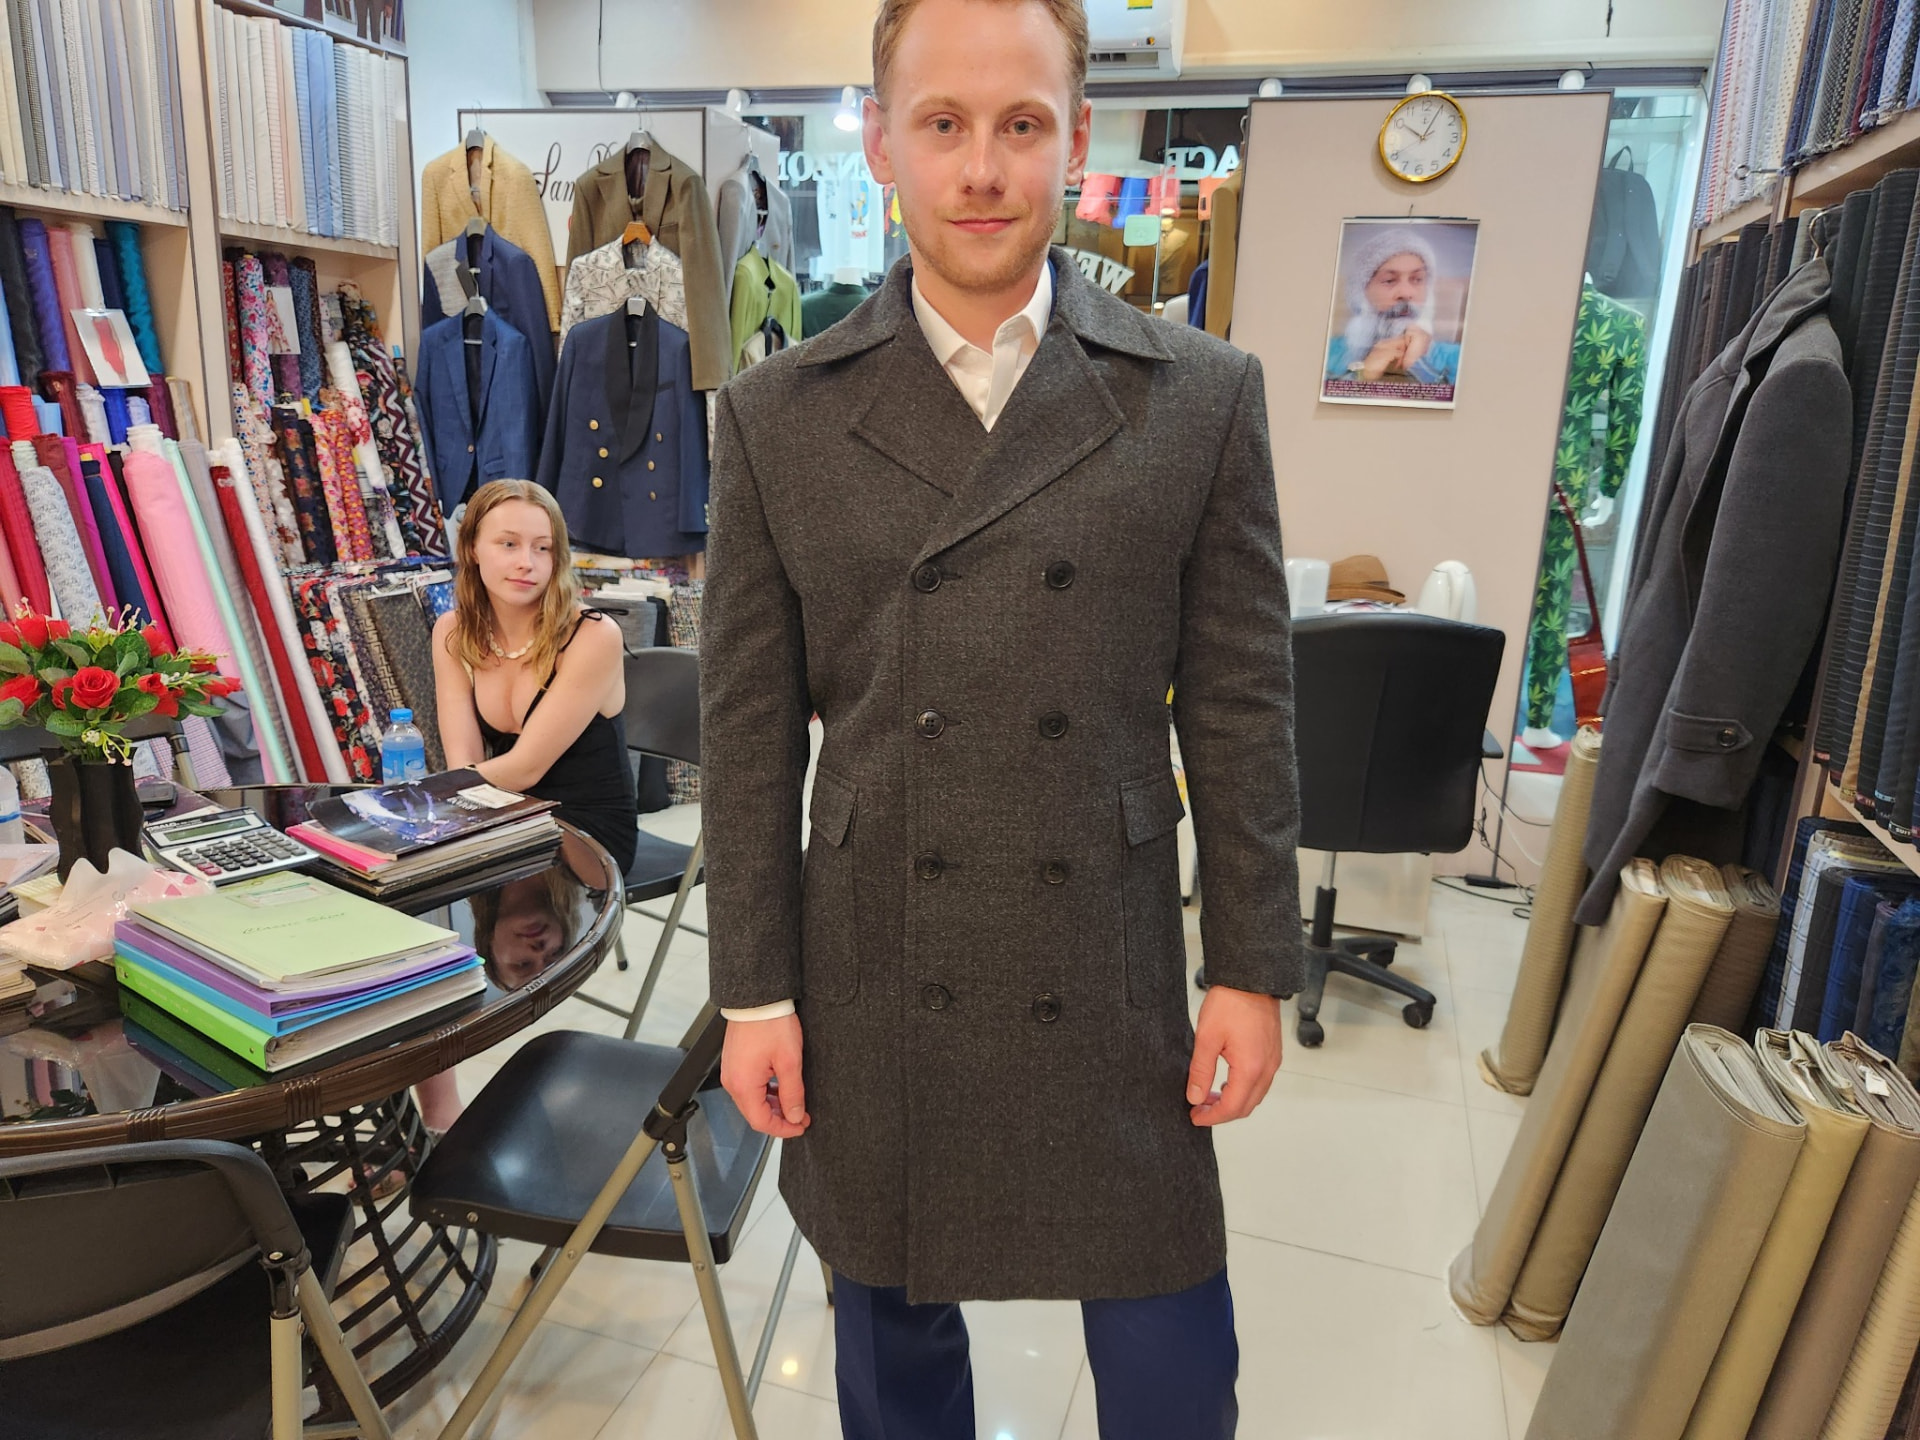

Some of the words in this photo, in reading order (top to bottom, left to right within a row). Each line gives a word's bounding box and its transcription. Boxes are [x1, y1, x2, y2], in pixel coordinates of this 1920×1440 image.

[1421, 100, 1432, 112] 12
[1406, 106, 1415, 117] 11
[1448, 115, 1456, 126] 2
[1450, 132, 1459, 143] 3
[1442, 147, 1451, 157] 4
[1402, 161, 1409, 171] 7
[1414, 165, 1423, 175] 6
[1430, 161, 1439, 171] 5
